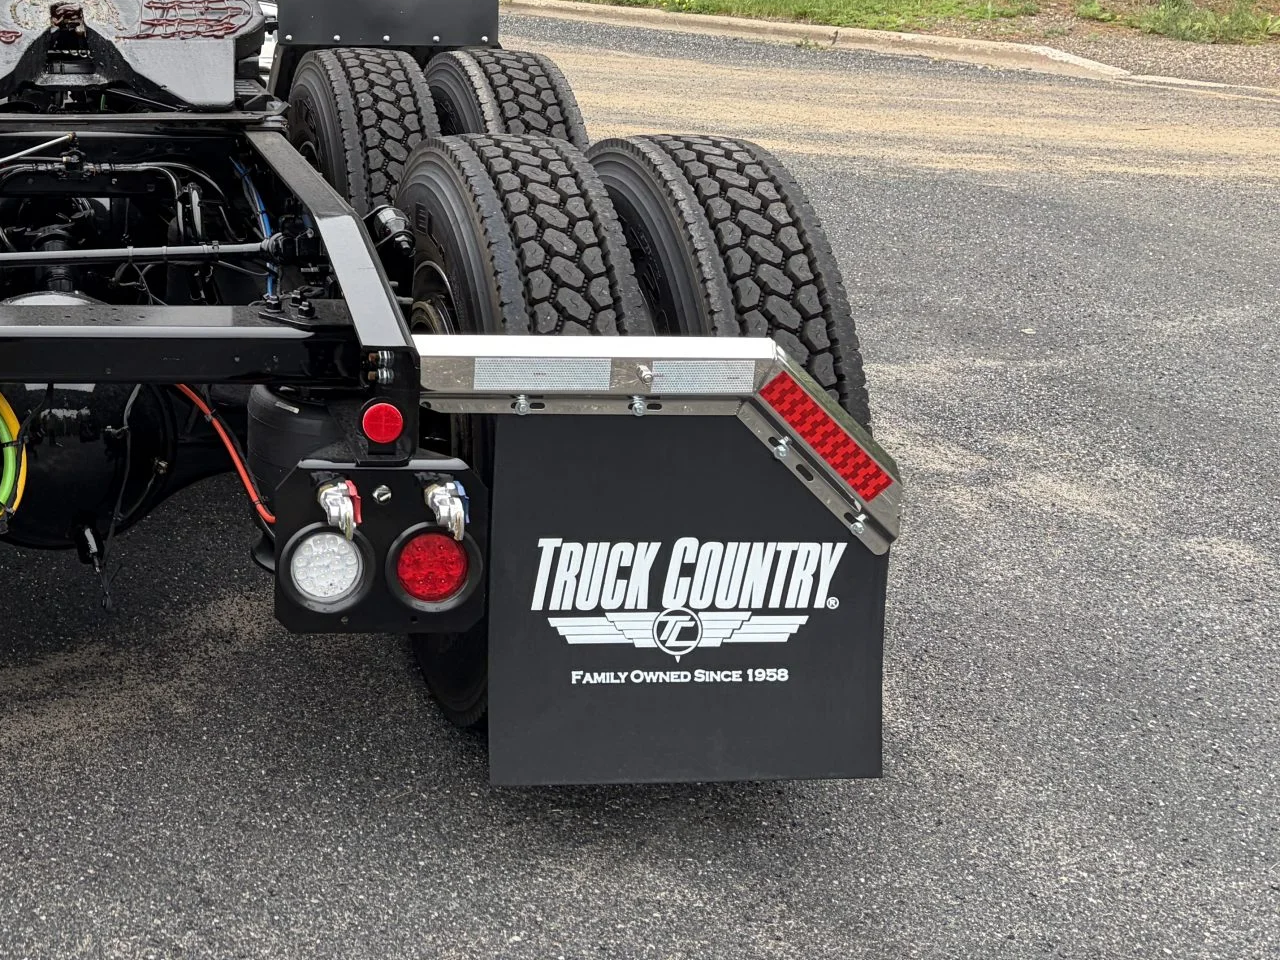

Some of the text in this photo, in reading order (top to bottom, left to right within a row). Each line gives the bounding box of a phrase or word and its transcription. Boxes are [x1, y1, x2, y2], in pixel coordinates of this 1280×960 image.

[530, 537, 662, 611] TRUCK
[570, 667, 790, 685] FAMILY OWNED SINCE 1958
